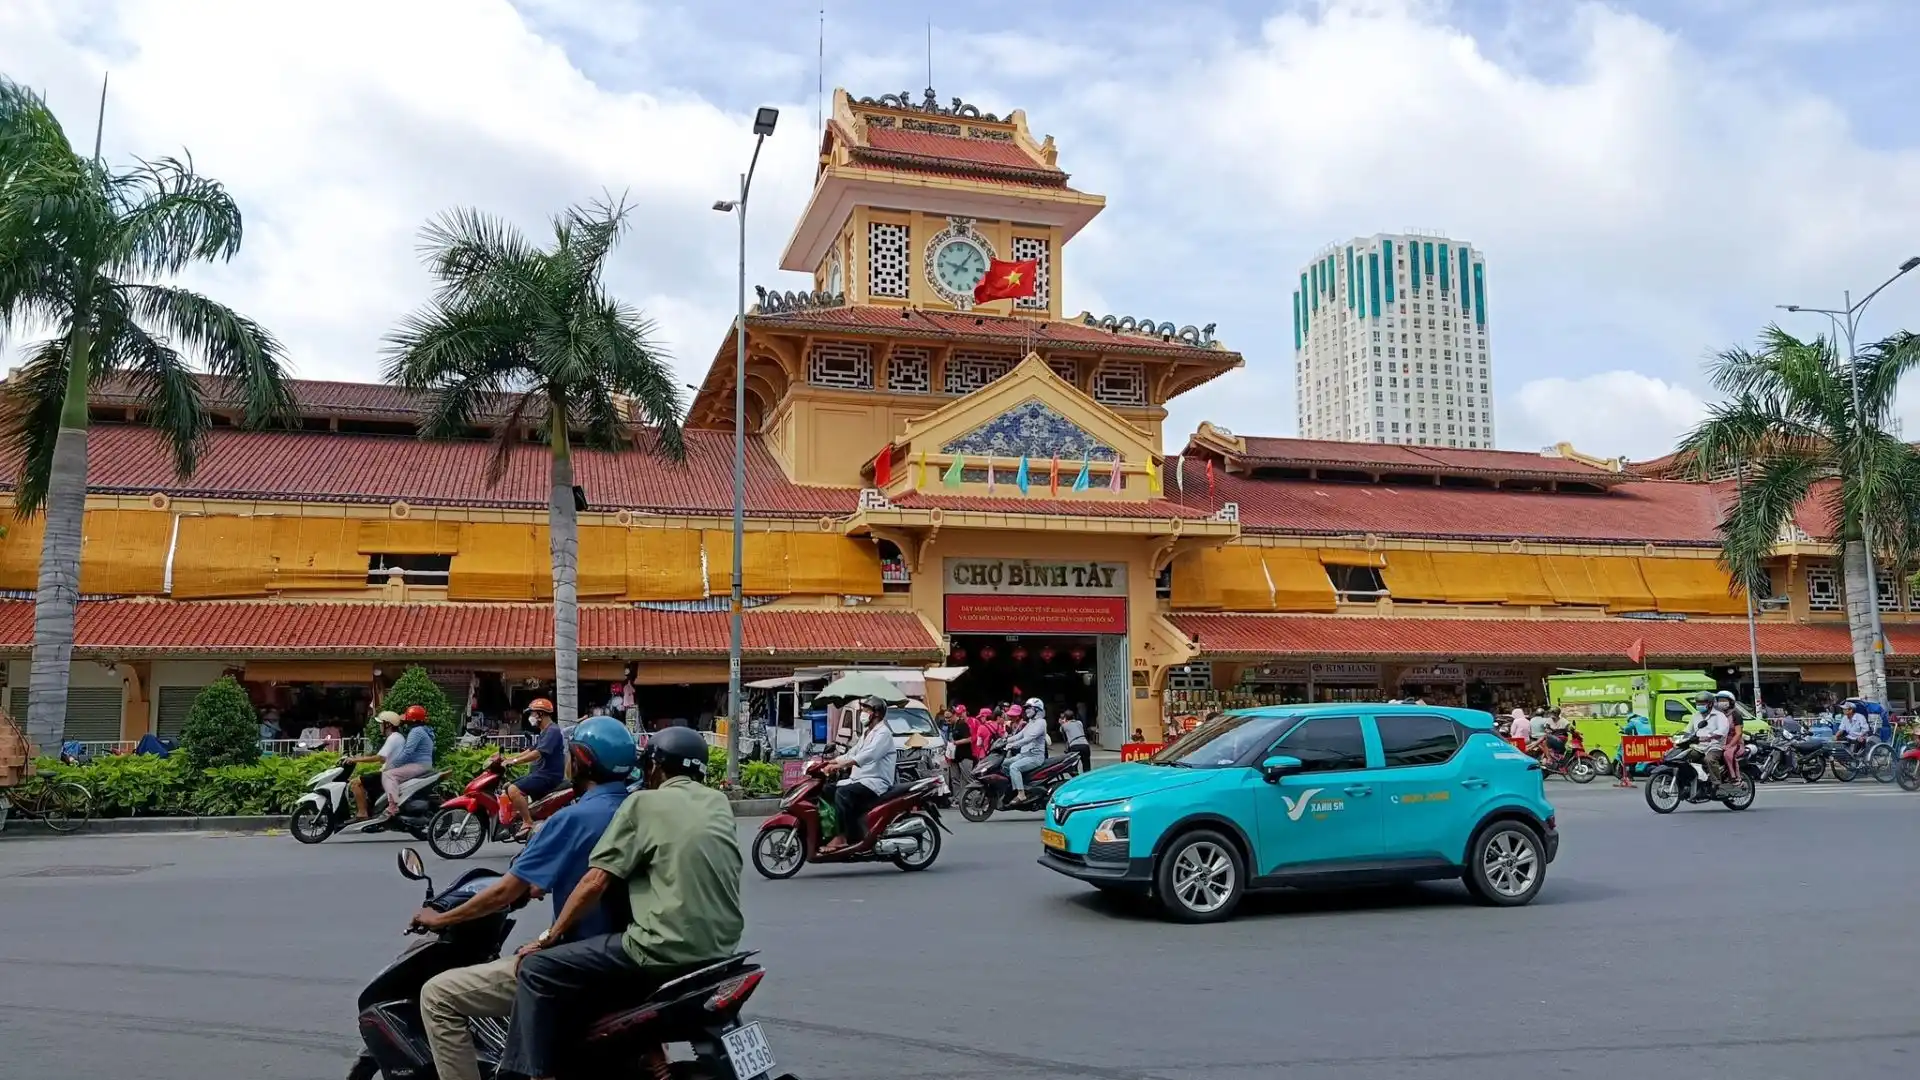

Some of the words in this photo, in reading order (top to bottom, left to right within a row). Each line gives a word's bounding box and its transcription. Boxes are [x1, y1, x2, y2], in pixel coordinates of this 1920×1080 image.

[953, 561, 1003, 591] CHỢ
[1008, 559, 1068, 587] BÌNH
[1072, 562, 1117, 588] TÂY
[1625, 738, 1645, 757] CẤM
[1311, 802, 1332, 812] XANH
[1333, 801, 1344, 811] SM
[734, 1046, 772, 1078] 315.96
